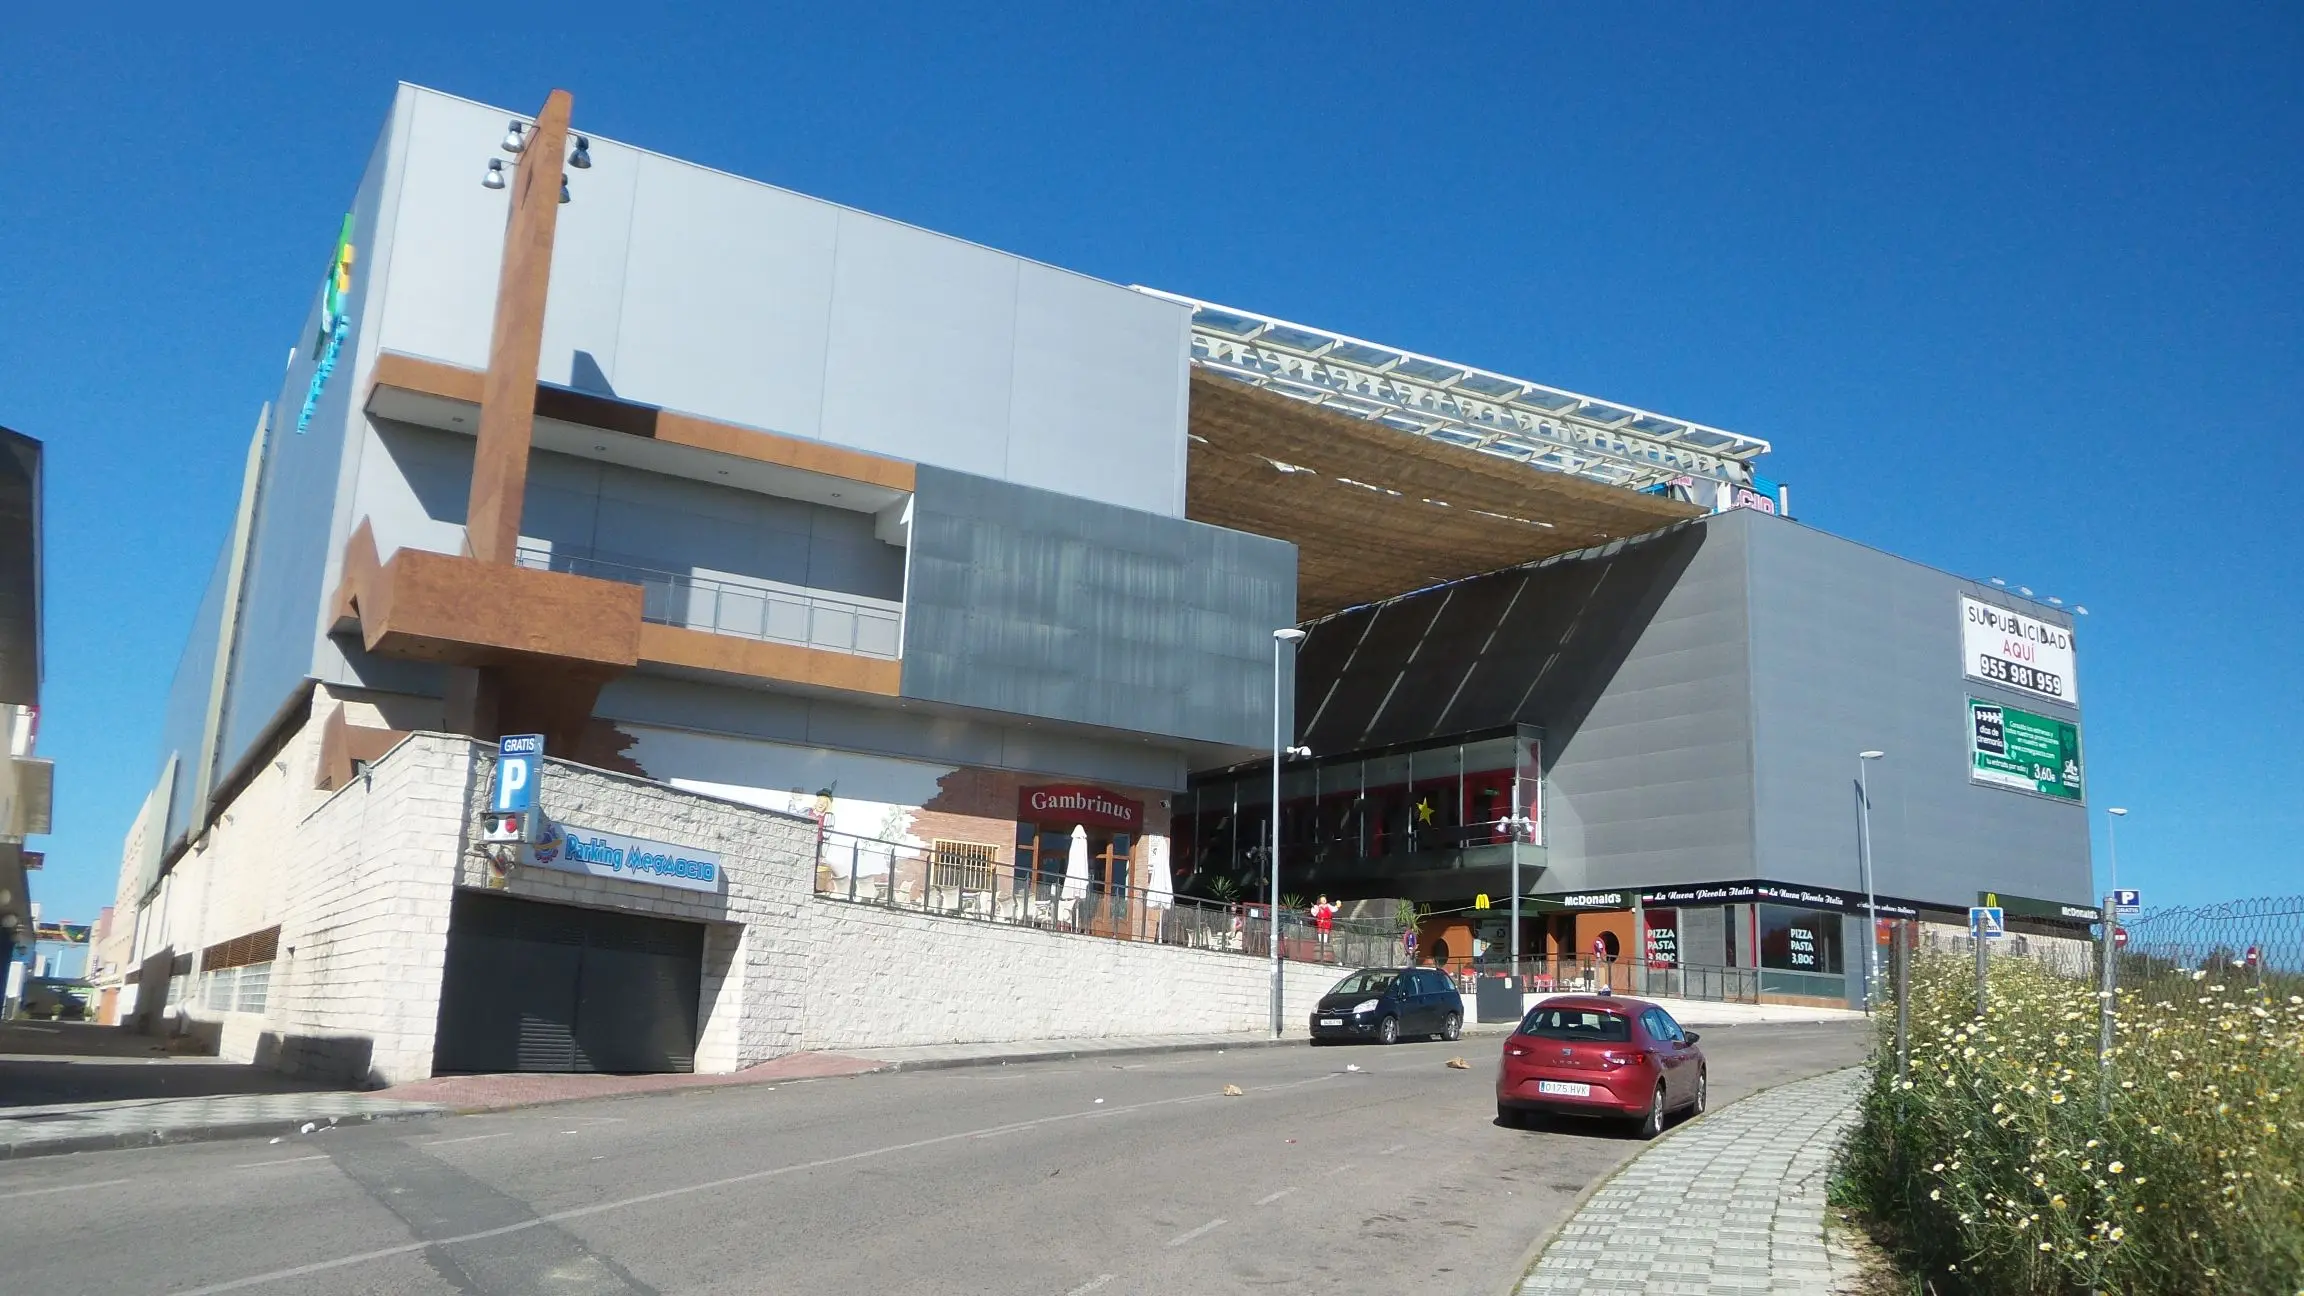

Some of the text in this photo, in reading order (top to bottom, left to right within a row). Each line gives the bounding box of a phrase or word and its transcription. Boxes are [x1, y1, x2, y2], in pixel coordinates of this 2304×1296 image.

[1968, 605, 2067, 650] SU PUBLICIDAD
[2002, 639, 2035, 663] AQUÍ
[1981, 656, 2062, 694] 955 981 959
[1991, 727, 2000, 737] de
[504, 738, 535, 752] GRATIS
[499, 758, 527, 809] P
[1031, 792, 1132, 820] Gambrinus
[565, 833, 624, 872] Parking
[1564, 892, 1622, 906] McDonald's
[1655, 892, 1667, 901] La
[1695, 889, 1727, 900] Piccola
[1728, 886, 1754, 897] Italia
[2121, 891, 2135, 905] P
[2061, 906, 2098, 920] McDonald's
[1647, 928, 1675, 939] PIZZA
[1790, 928, 1813, 940] PIZZA
[1647, 940, 1676, 950] PASTA
[1790, 940, 1814, 952] PASTA
[1791, 952, 1814, 965] 3,80€
[1545, 1083, 1587, 1095] 0175 HVK
